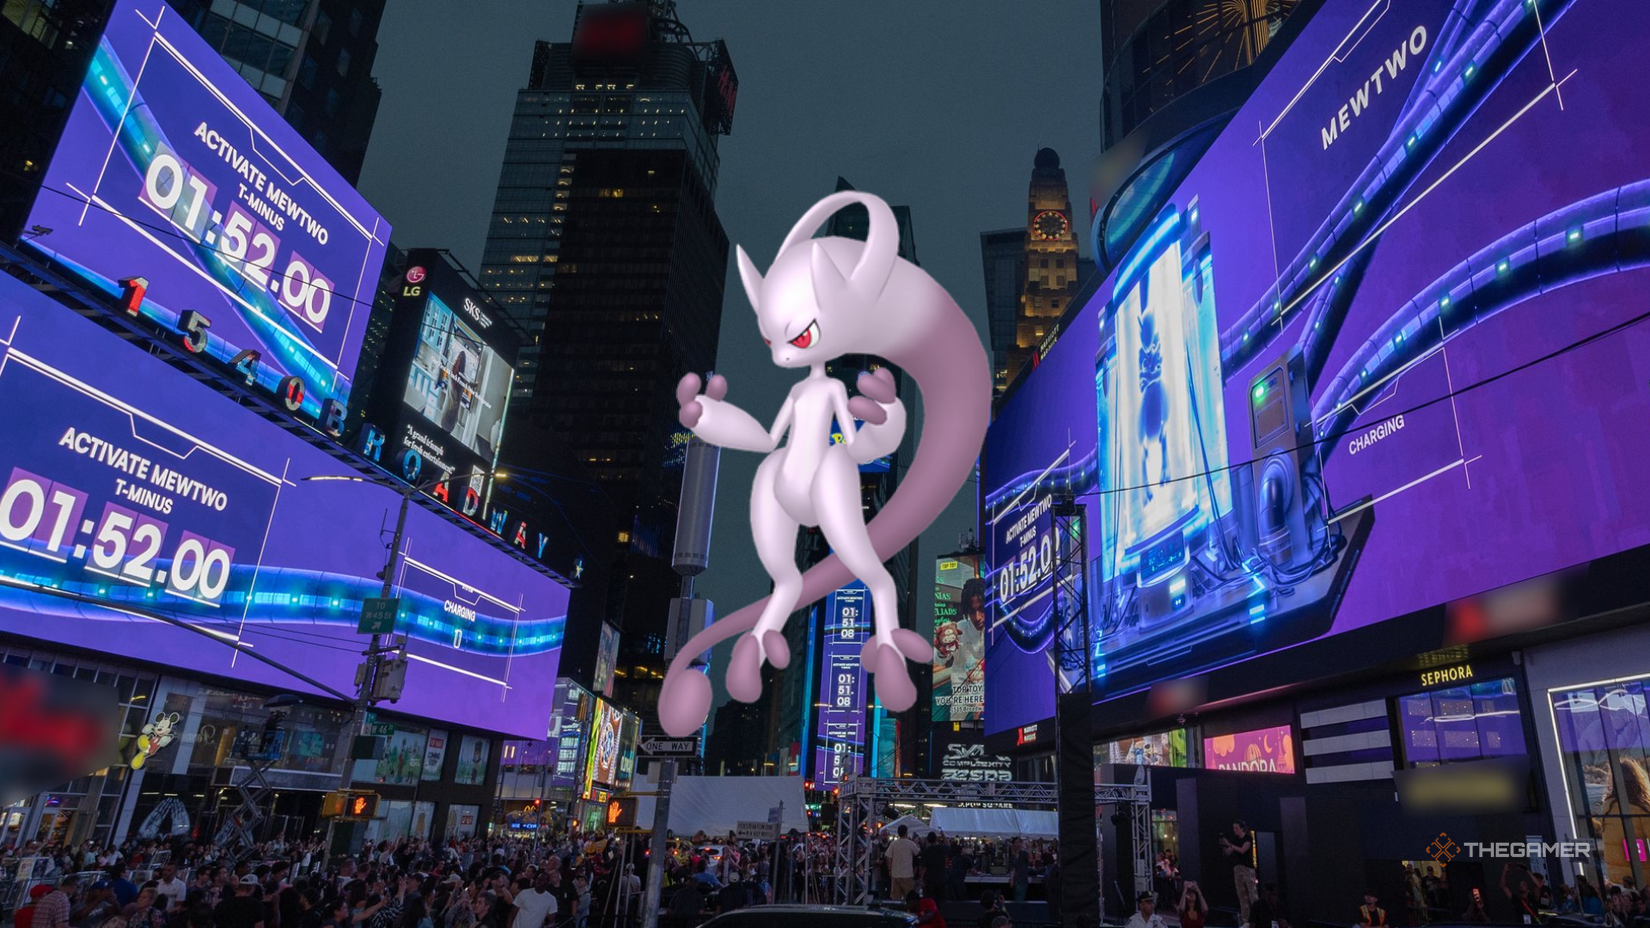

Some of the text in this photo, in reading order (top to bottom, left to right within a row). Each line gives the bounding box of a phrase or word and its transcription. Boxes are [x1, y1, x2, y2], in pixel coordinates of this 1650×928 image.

[1321, 25, 1427, 150] MEWTWO
[194, 121, 329, 246] ACTIVATE MEWTWO
[238, 182, 285, 231] T-MINUS
[145, 153, 331, 324] 01:52.00
[403, 286, 421, 297] LG
[463, 297, 481, 322] SKS
[117, 275, 307, 412] 1540
[1349, 414, 1405, 455] CHARGING
[58, 427, 228, 511] ACTIVATE MEWTWO
[323, 397, 549, 559] BROADWAY
[115, 478, 174, 515] T-MINUS
[1005, 493, 1053, 544] ACTIVATE MEWTWO
[0, 478, 230, 599] 01:52.00
[1020, 525, 1037, 548] T-MINUS
[444, 599, 476, 622] CHARGING
[842, 607, 858, 617] 01:
[841, 618, 858, 627] 51.
[841, 629, 855, 638] 08
[838, 674, 855, 683] 01:
[1421, 664, 1473, 686] SEPHORA
[837, 697, 851, 706] 08
[838, 686, 854, 695] 51.
[964, 695, 983, 703] HERE
[378, 725, 387, 734] 46
[646, 741, 690, 751] ONE WAY
[1218, 757, 1277, 773] PANDORA
